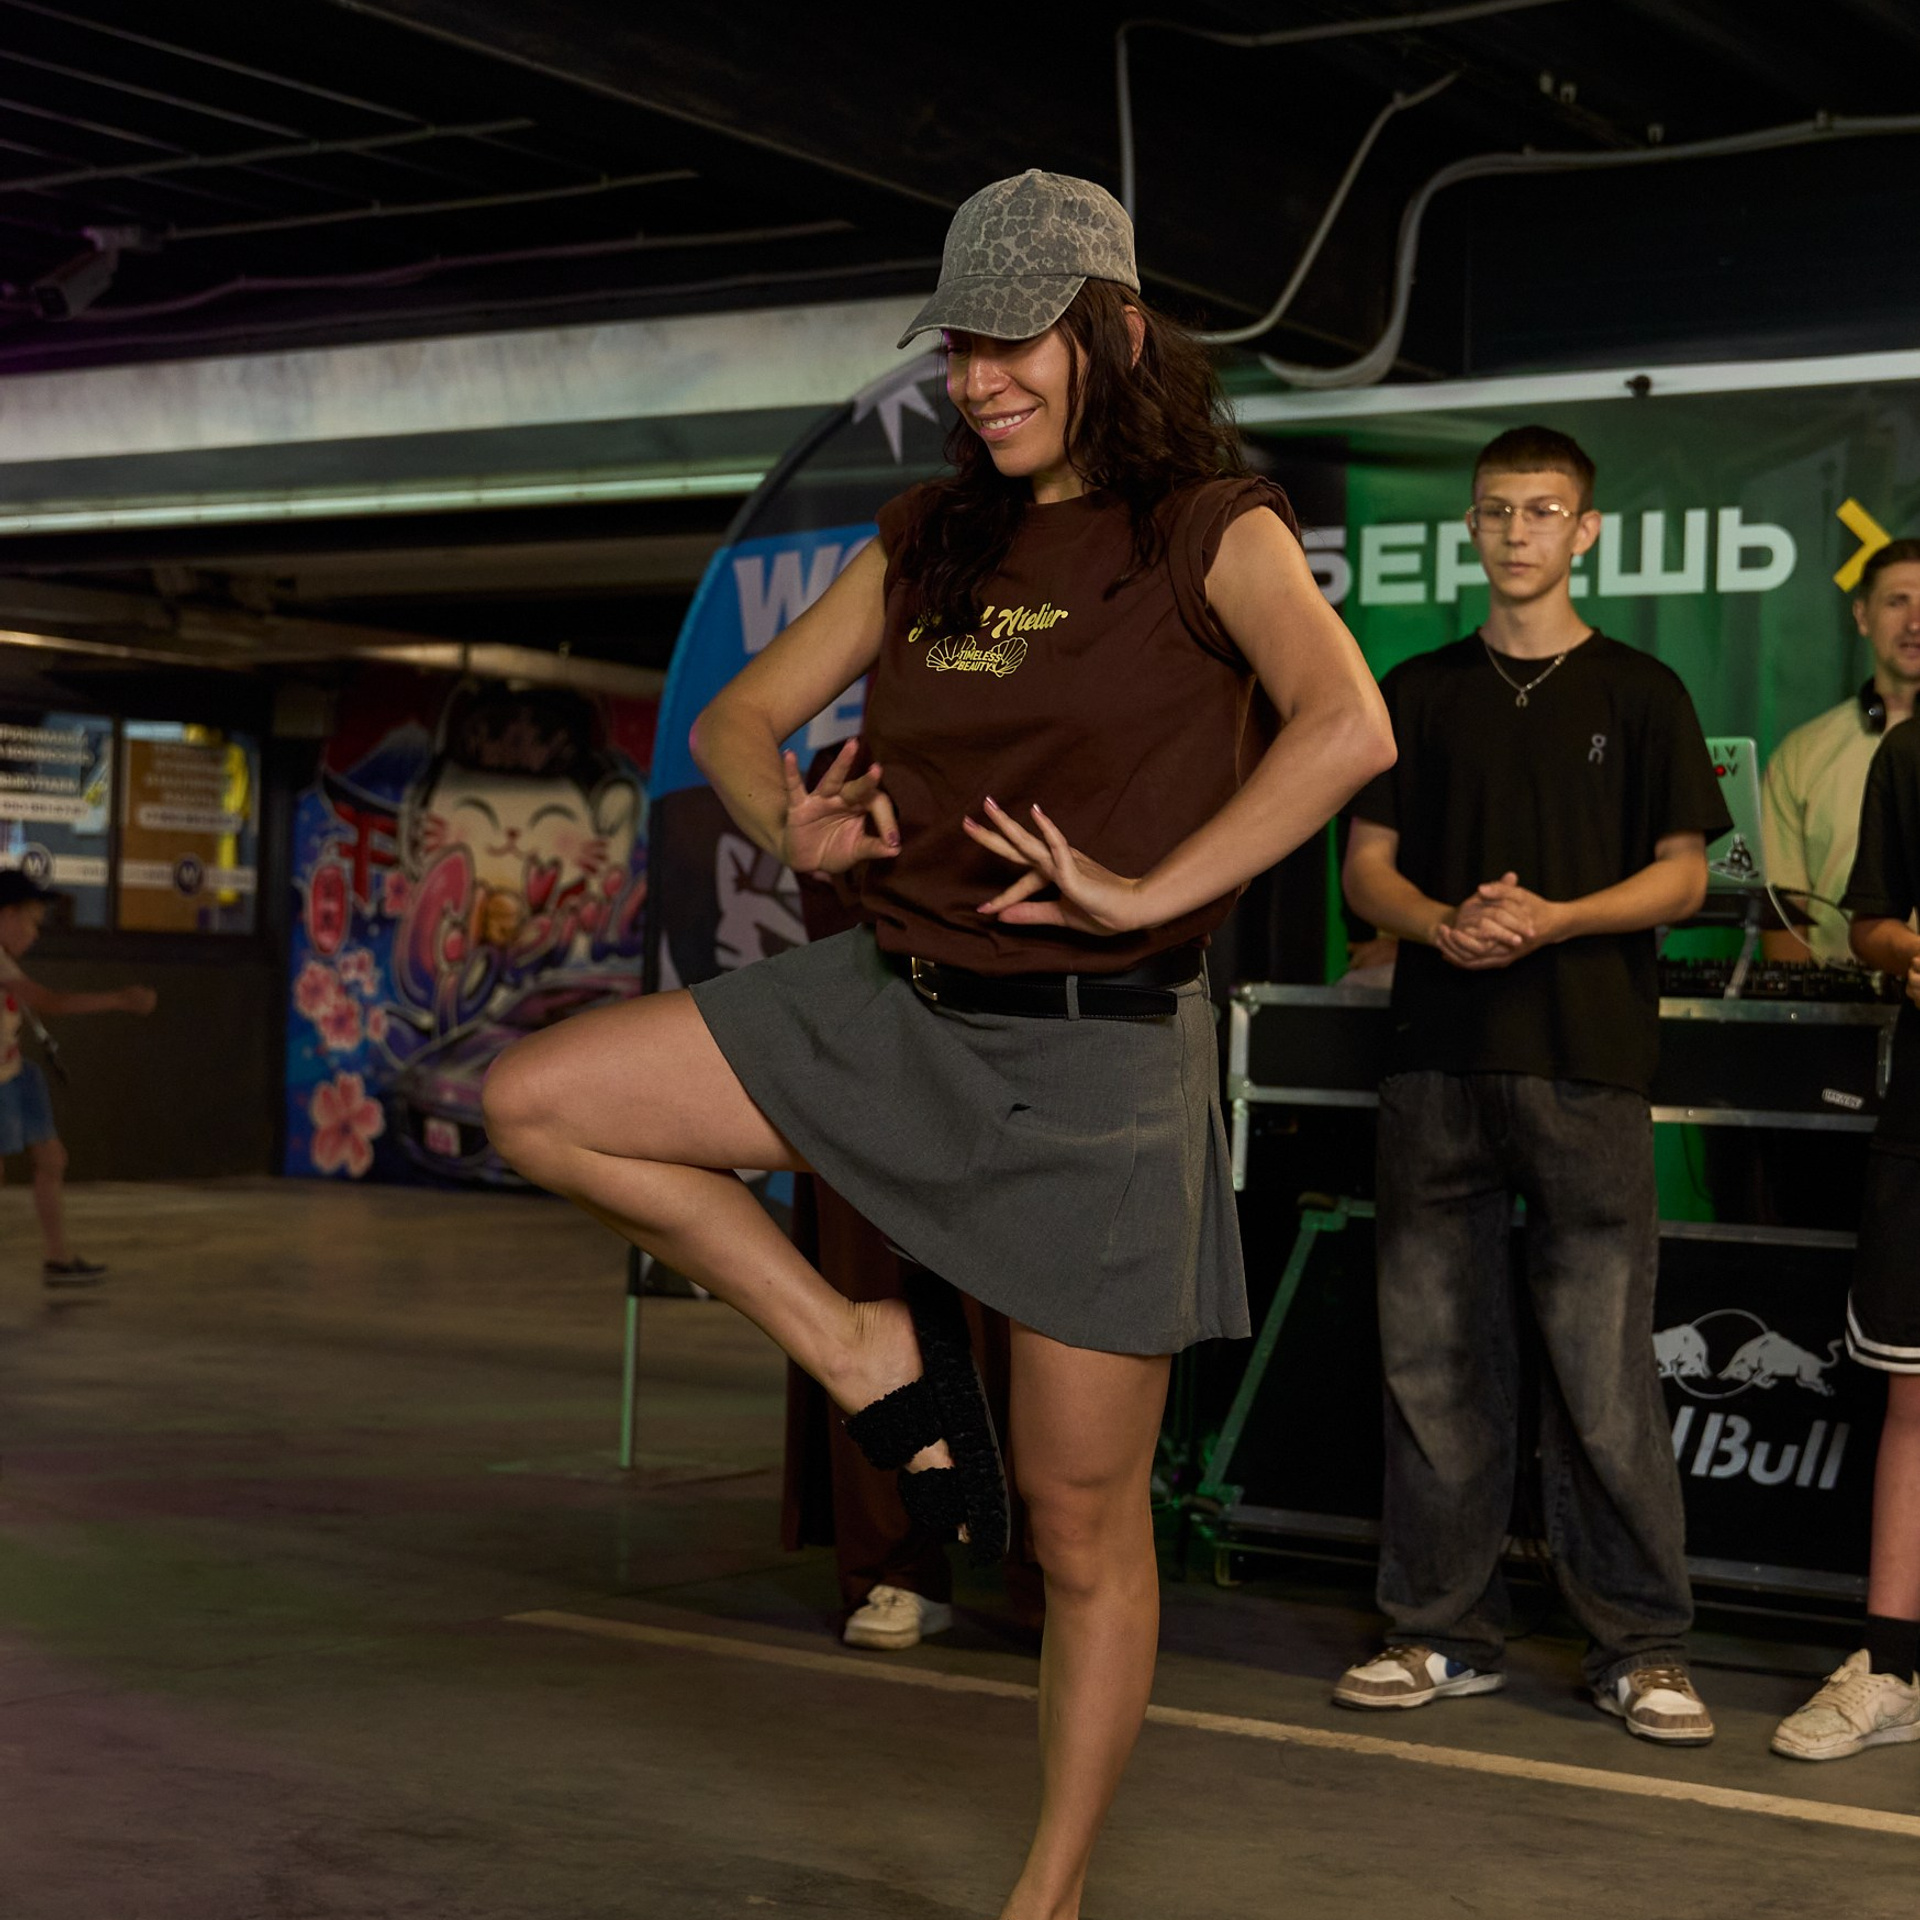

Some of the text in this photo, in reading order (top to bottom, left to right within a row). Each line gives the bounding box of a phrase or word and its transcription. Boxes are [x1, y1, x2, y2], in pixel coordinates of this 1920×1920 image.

[958, 649, 1003, 663] TIMELESS
[957, 660, 993, 672] BEAUTY
[1690, 1412, 1850, 1490] Bull
